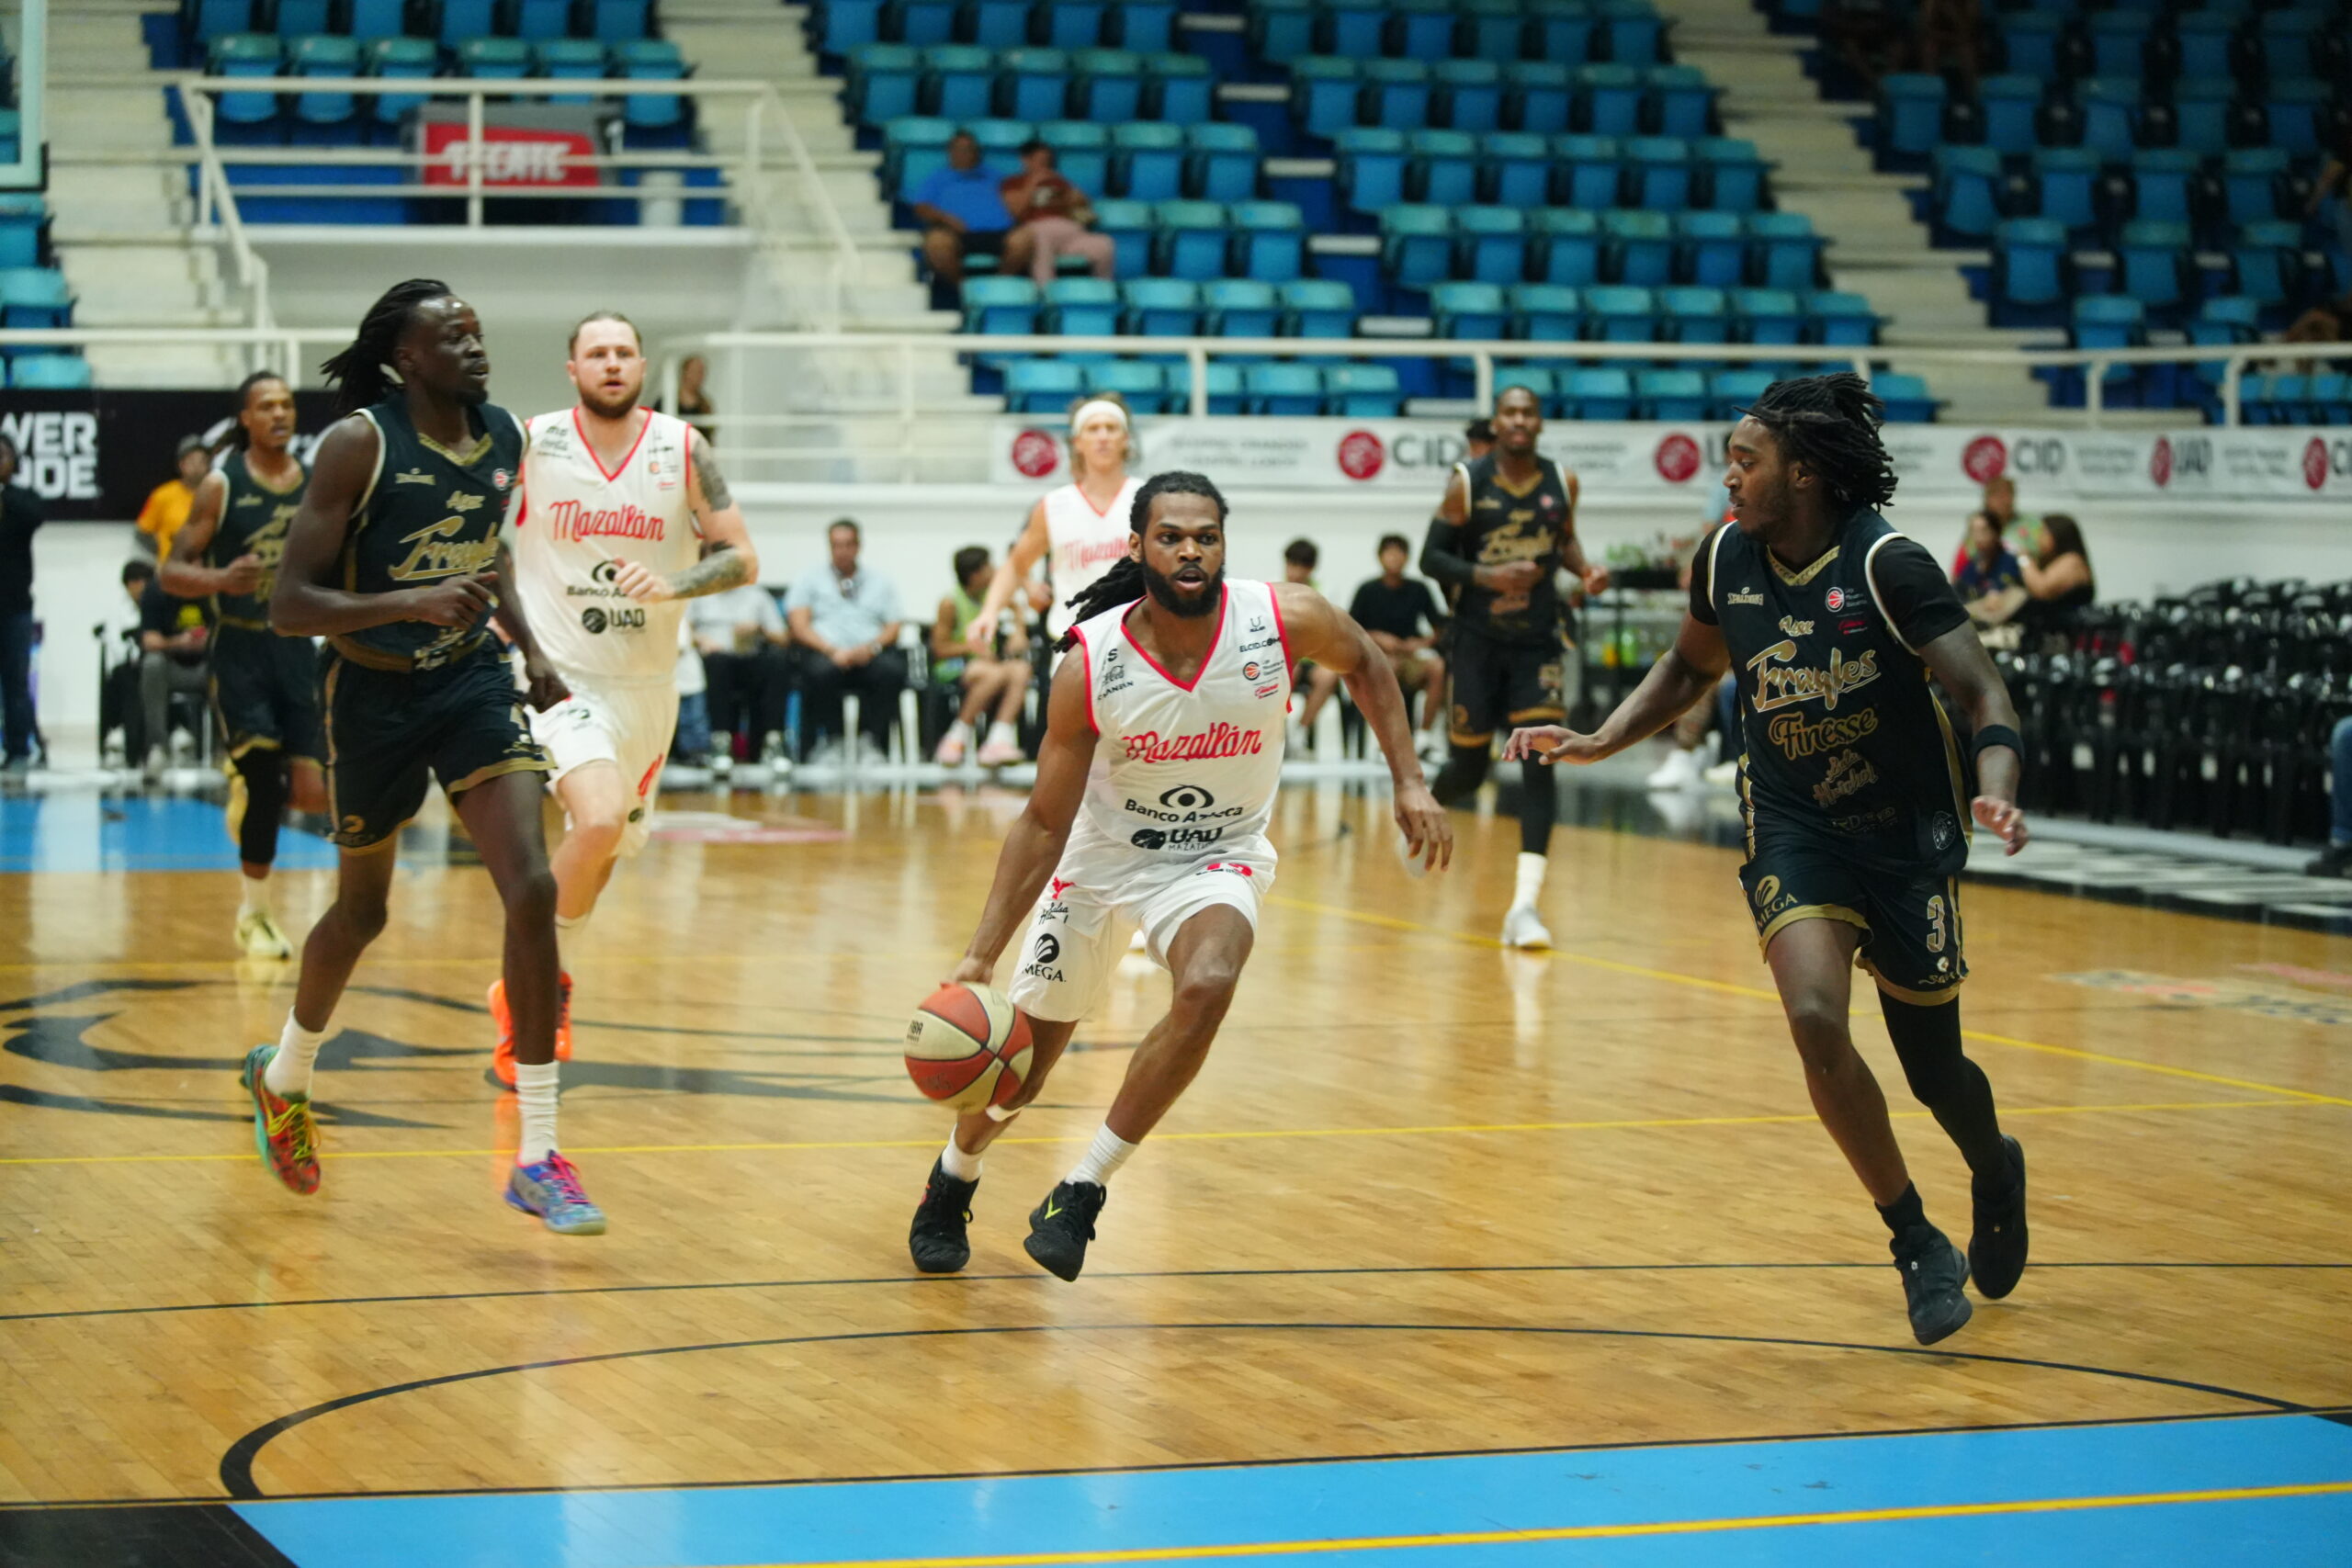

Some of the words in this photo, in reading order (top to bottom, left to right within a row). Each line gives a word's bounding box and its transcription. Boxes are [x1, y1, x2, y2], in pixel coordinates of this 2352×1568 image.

[548, 499, 665, 543] Mazatlán
[610, 608, 646, 628] UAD
[1747, 639, 1882, 713] Frayles
[1122, 722, 1262, 763] Mazatlán
[1769, 707, 1878, 761] Finesse
[1125, 798, 1180, 823] Banco
[1927, 895, 1947, 953] 3
